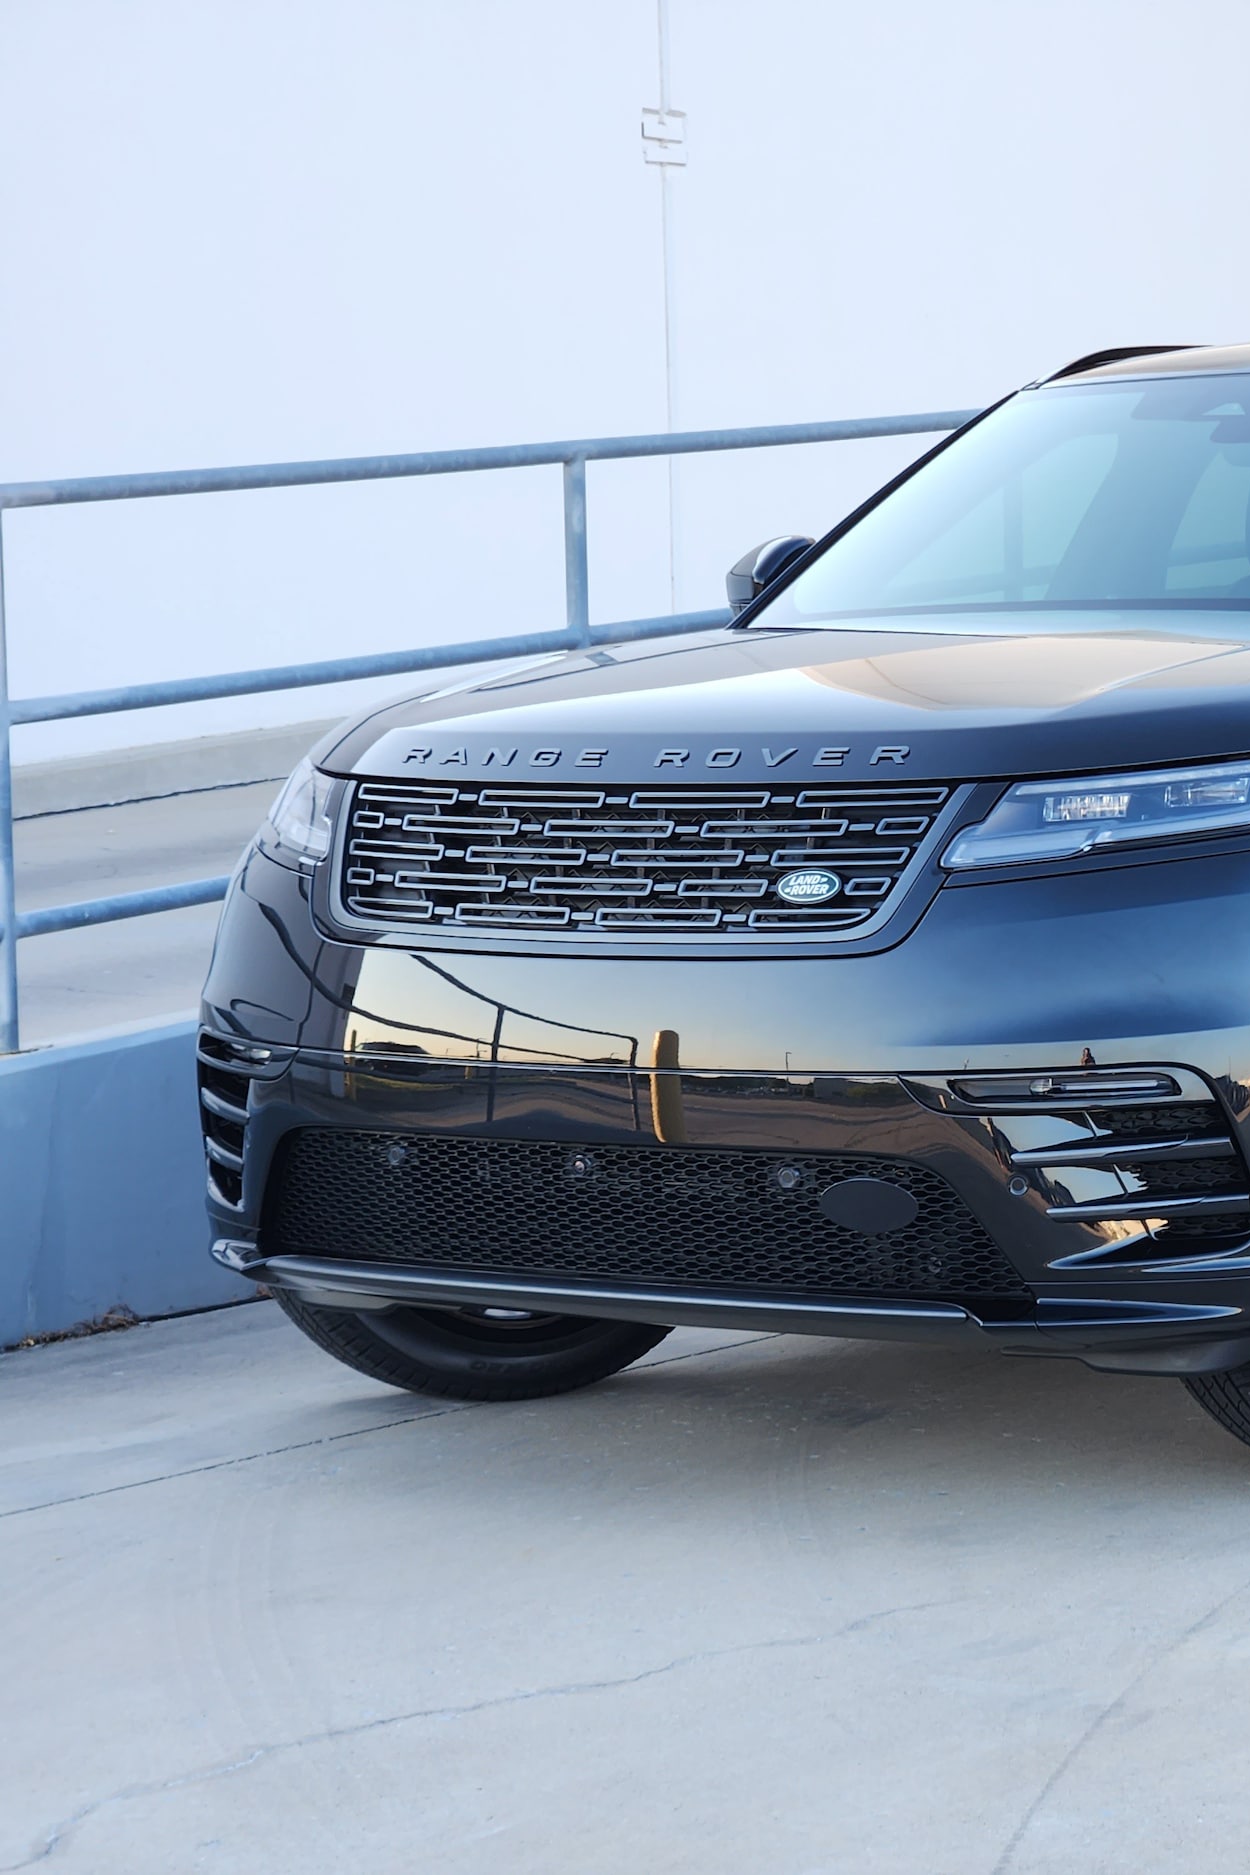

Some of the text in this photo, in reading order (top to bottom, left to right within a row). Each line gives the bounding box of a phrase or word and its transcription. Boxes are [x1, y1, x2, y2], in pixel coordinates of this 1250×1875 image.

[401, 745, 911, 768] RANGE ROVER
[789, 875, 821, 885] LAND
[790, 884, 829, 896] ROVER
